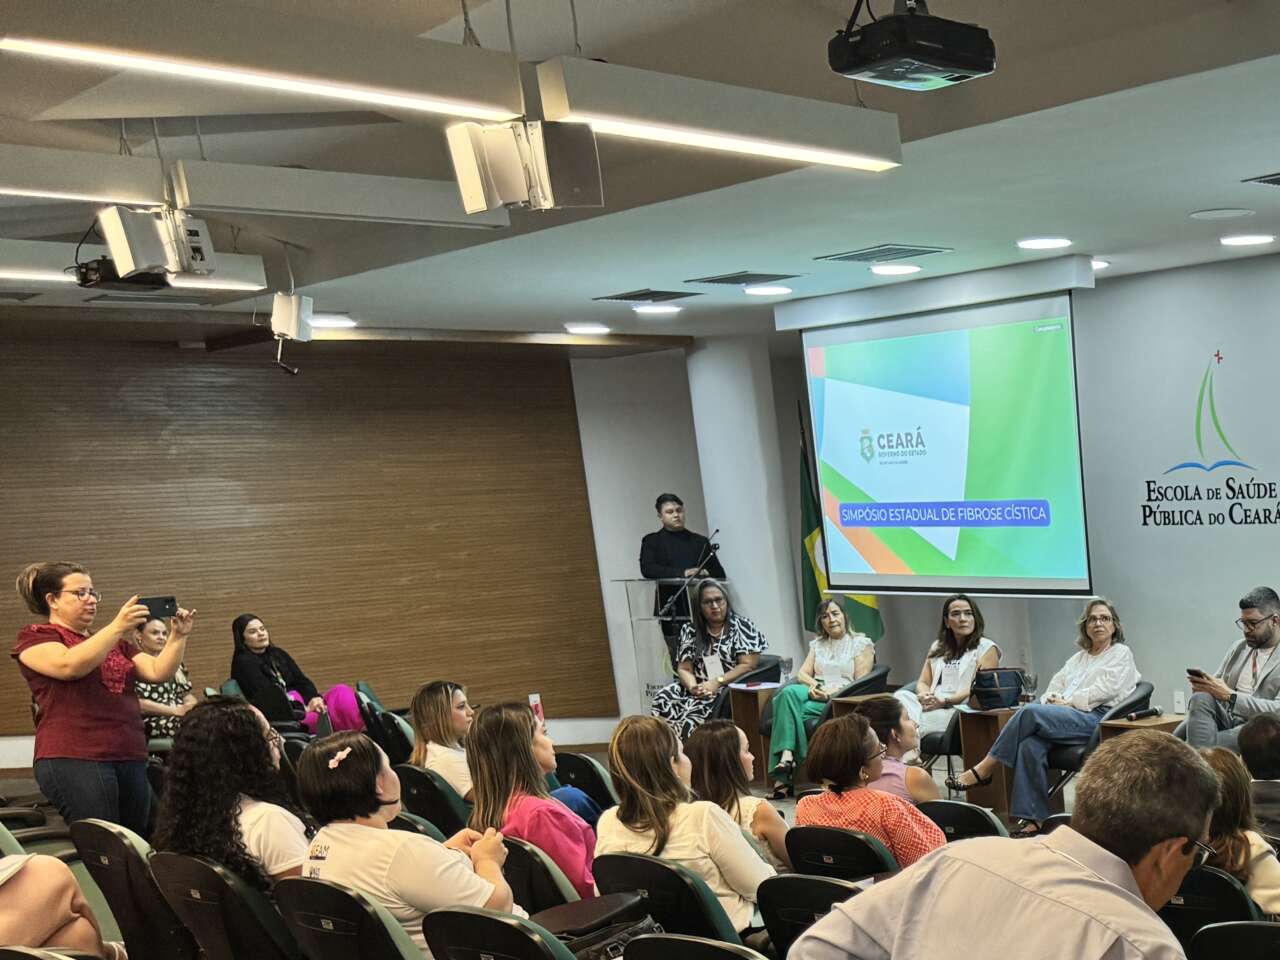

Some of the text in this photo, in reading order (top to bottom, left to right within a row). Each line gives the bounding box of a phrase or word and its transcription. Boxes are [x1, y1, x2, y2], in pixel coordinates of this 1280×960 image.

[877, 425, 926, 450] CEARÁ
[842, 504, 1046, 521] SIMPÓSIO ESTADUAL DE FIBROSE CÍSTICA
